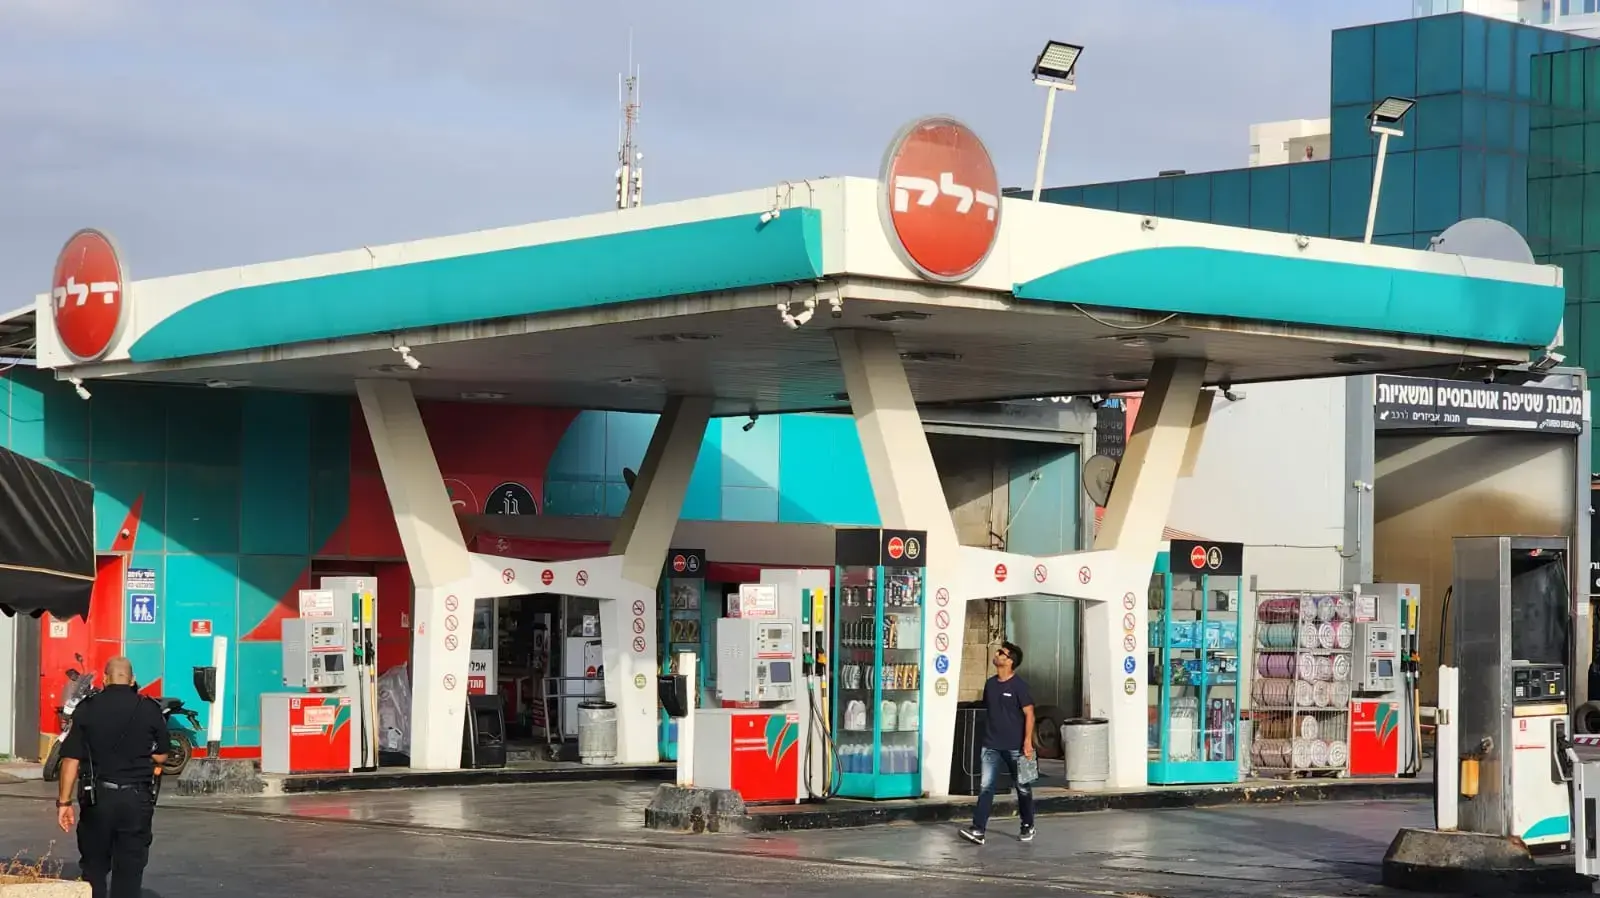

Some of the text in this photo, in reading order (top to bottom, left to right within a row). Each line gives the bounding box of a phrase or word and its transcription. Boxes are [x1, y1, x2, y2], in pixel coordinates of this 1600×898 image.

[894, 172, 998, 221] דלק
[53, 276, 119, 318] דלק
[1379, 383, 1582, 415] מכונת שטיפה אוטובוסים ומשאיות
[1443, 413, 1460, 423] חנות
